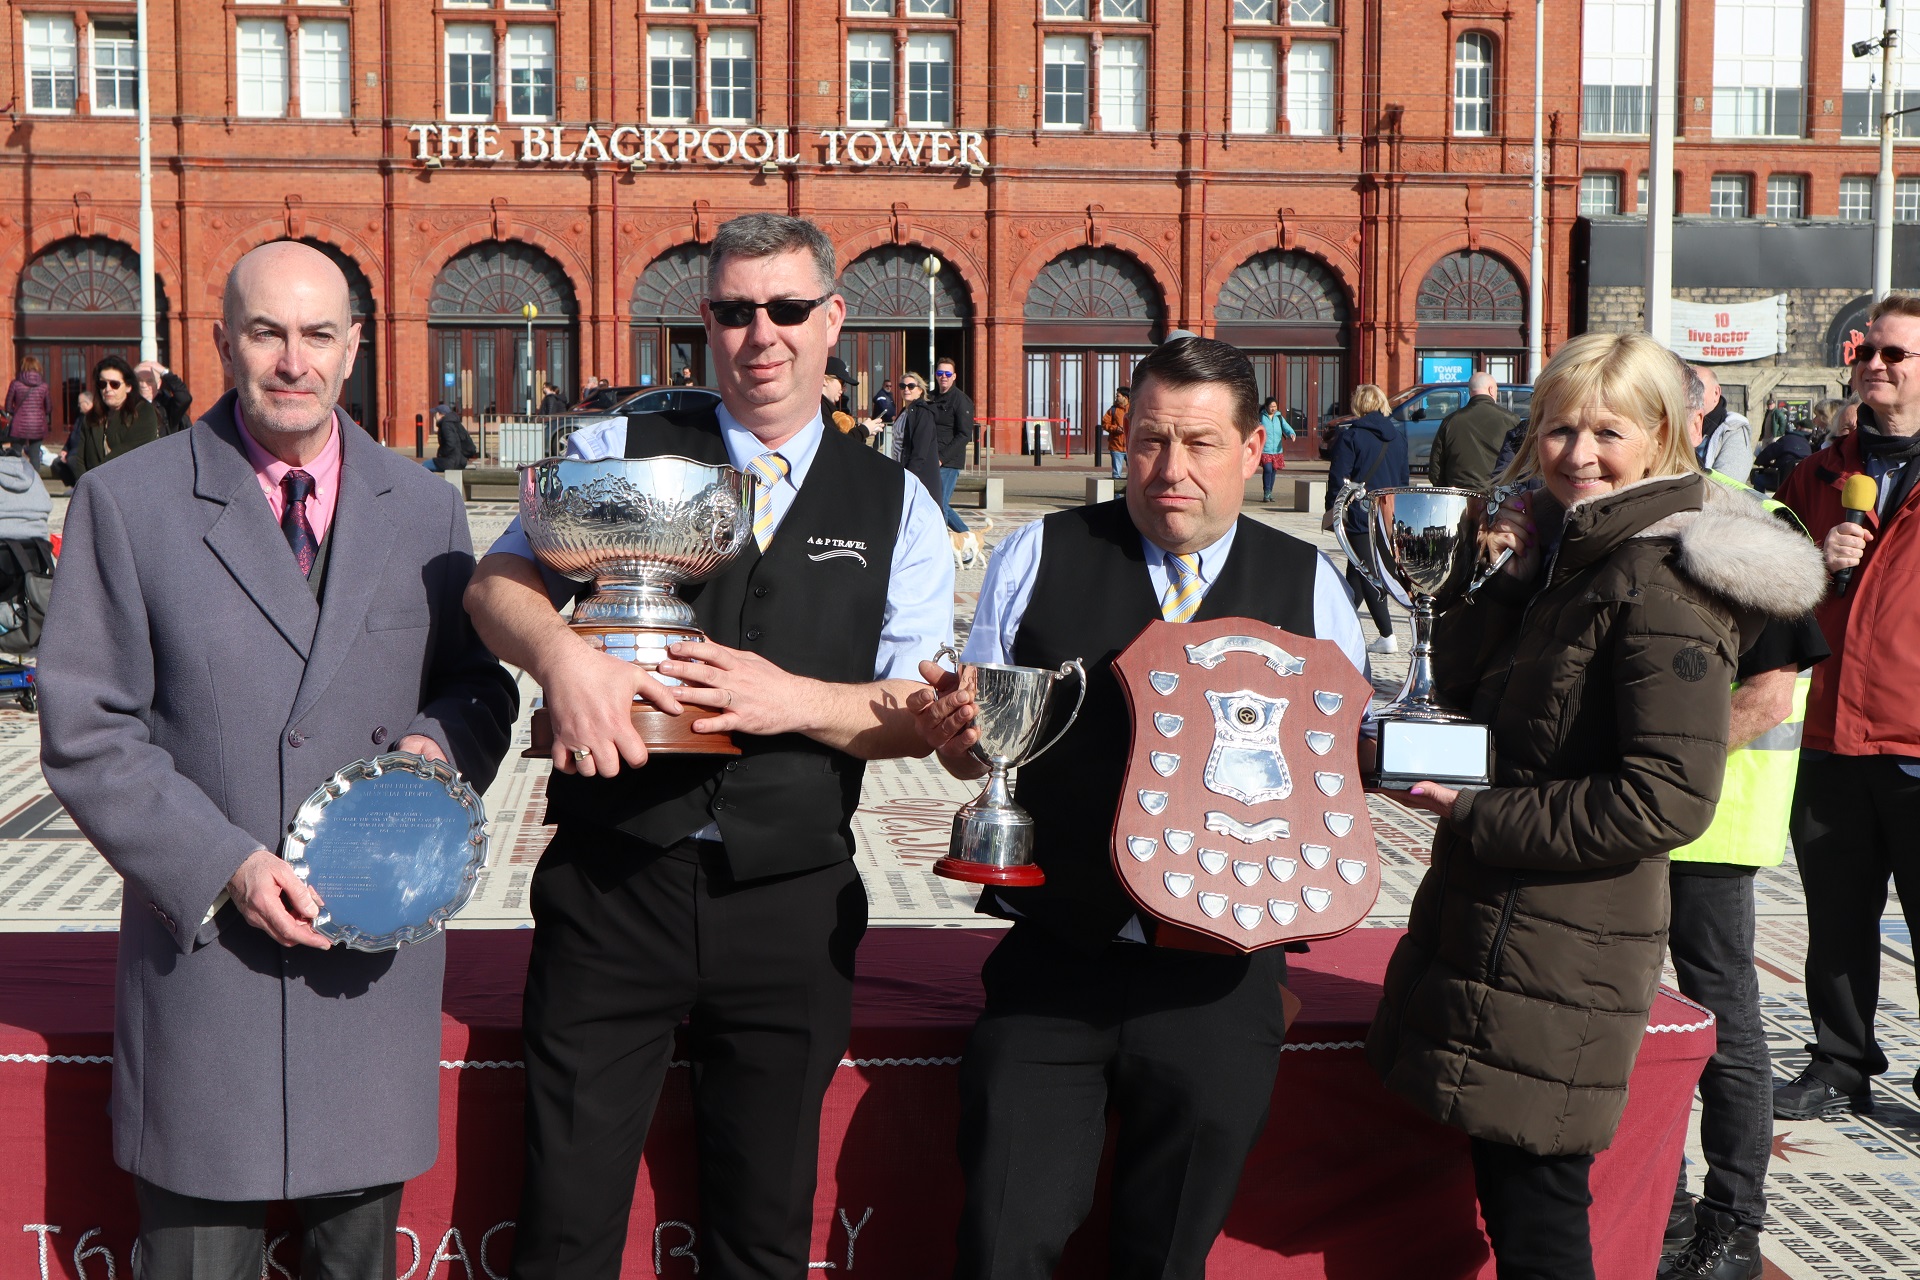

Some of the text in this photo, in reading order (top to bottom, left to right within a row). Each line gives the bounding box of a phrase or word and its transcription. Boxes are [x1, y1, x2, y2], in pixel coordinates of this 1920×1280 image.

[410, 124, 990, 168] THE BLACKPOOL TOWER
[1714, 312, 1730, 328] 10
[1688, 329, 1750, 343] live actor
[1702, 346, 1744, 357] shows
[807, 536, 814, 544] A
[824, 538, 831, 546] P
[831, 539, 868, 550] TRAVEL
[1804, 1172, 1835, 1181] ON
[1786, 1186, 1817, 1194] SO
[1801, 1196, 1840, 1210] FEEL
[1770, 1202, 1840, 1239] SOMETIMES
[1821, 1240, 1872, 1263] CLOGS
